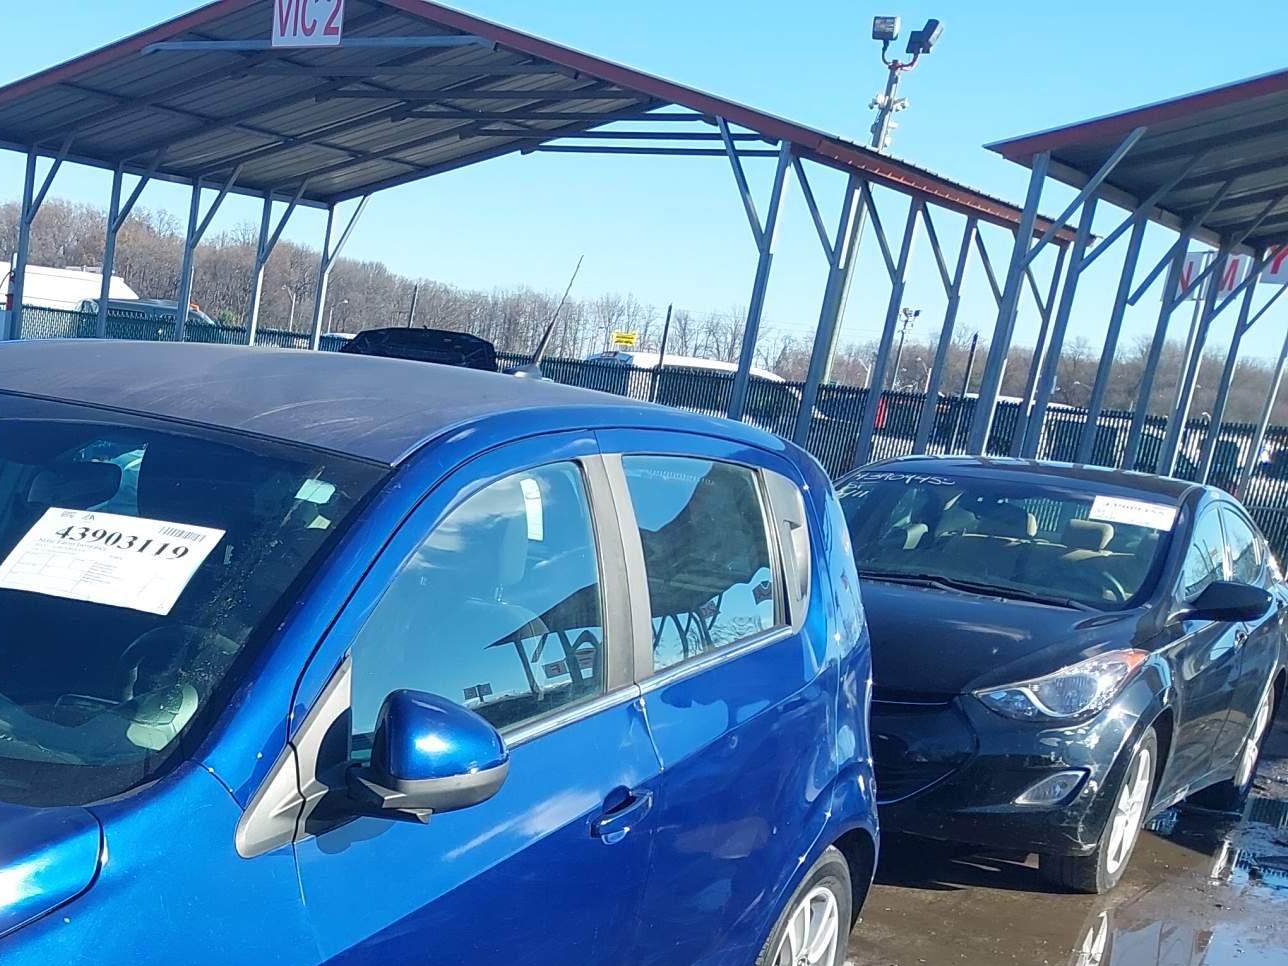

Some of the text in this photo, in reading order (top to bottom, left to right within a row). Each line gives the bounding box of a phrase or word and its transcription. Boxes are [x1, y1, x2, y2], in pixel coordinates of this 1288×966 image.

[278, 0, 342, 37] VIC 2
[55, 525, 189, 560] 43903119
